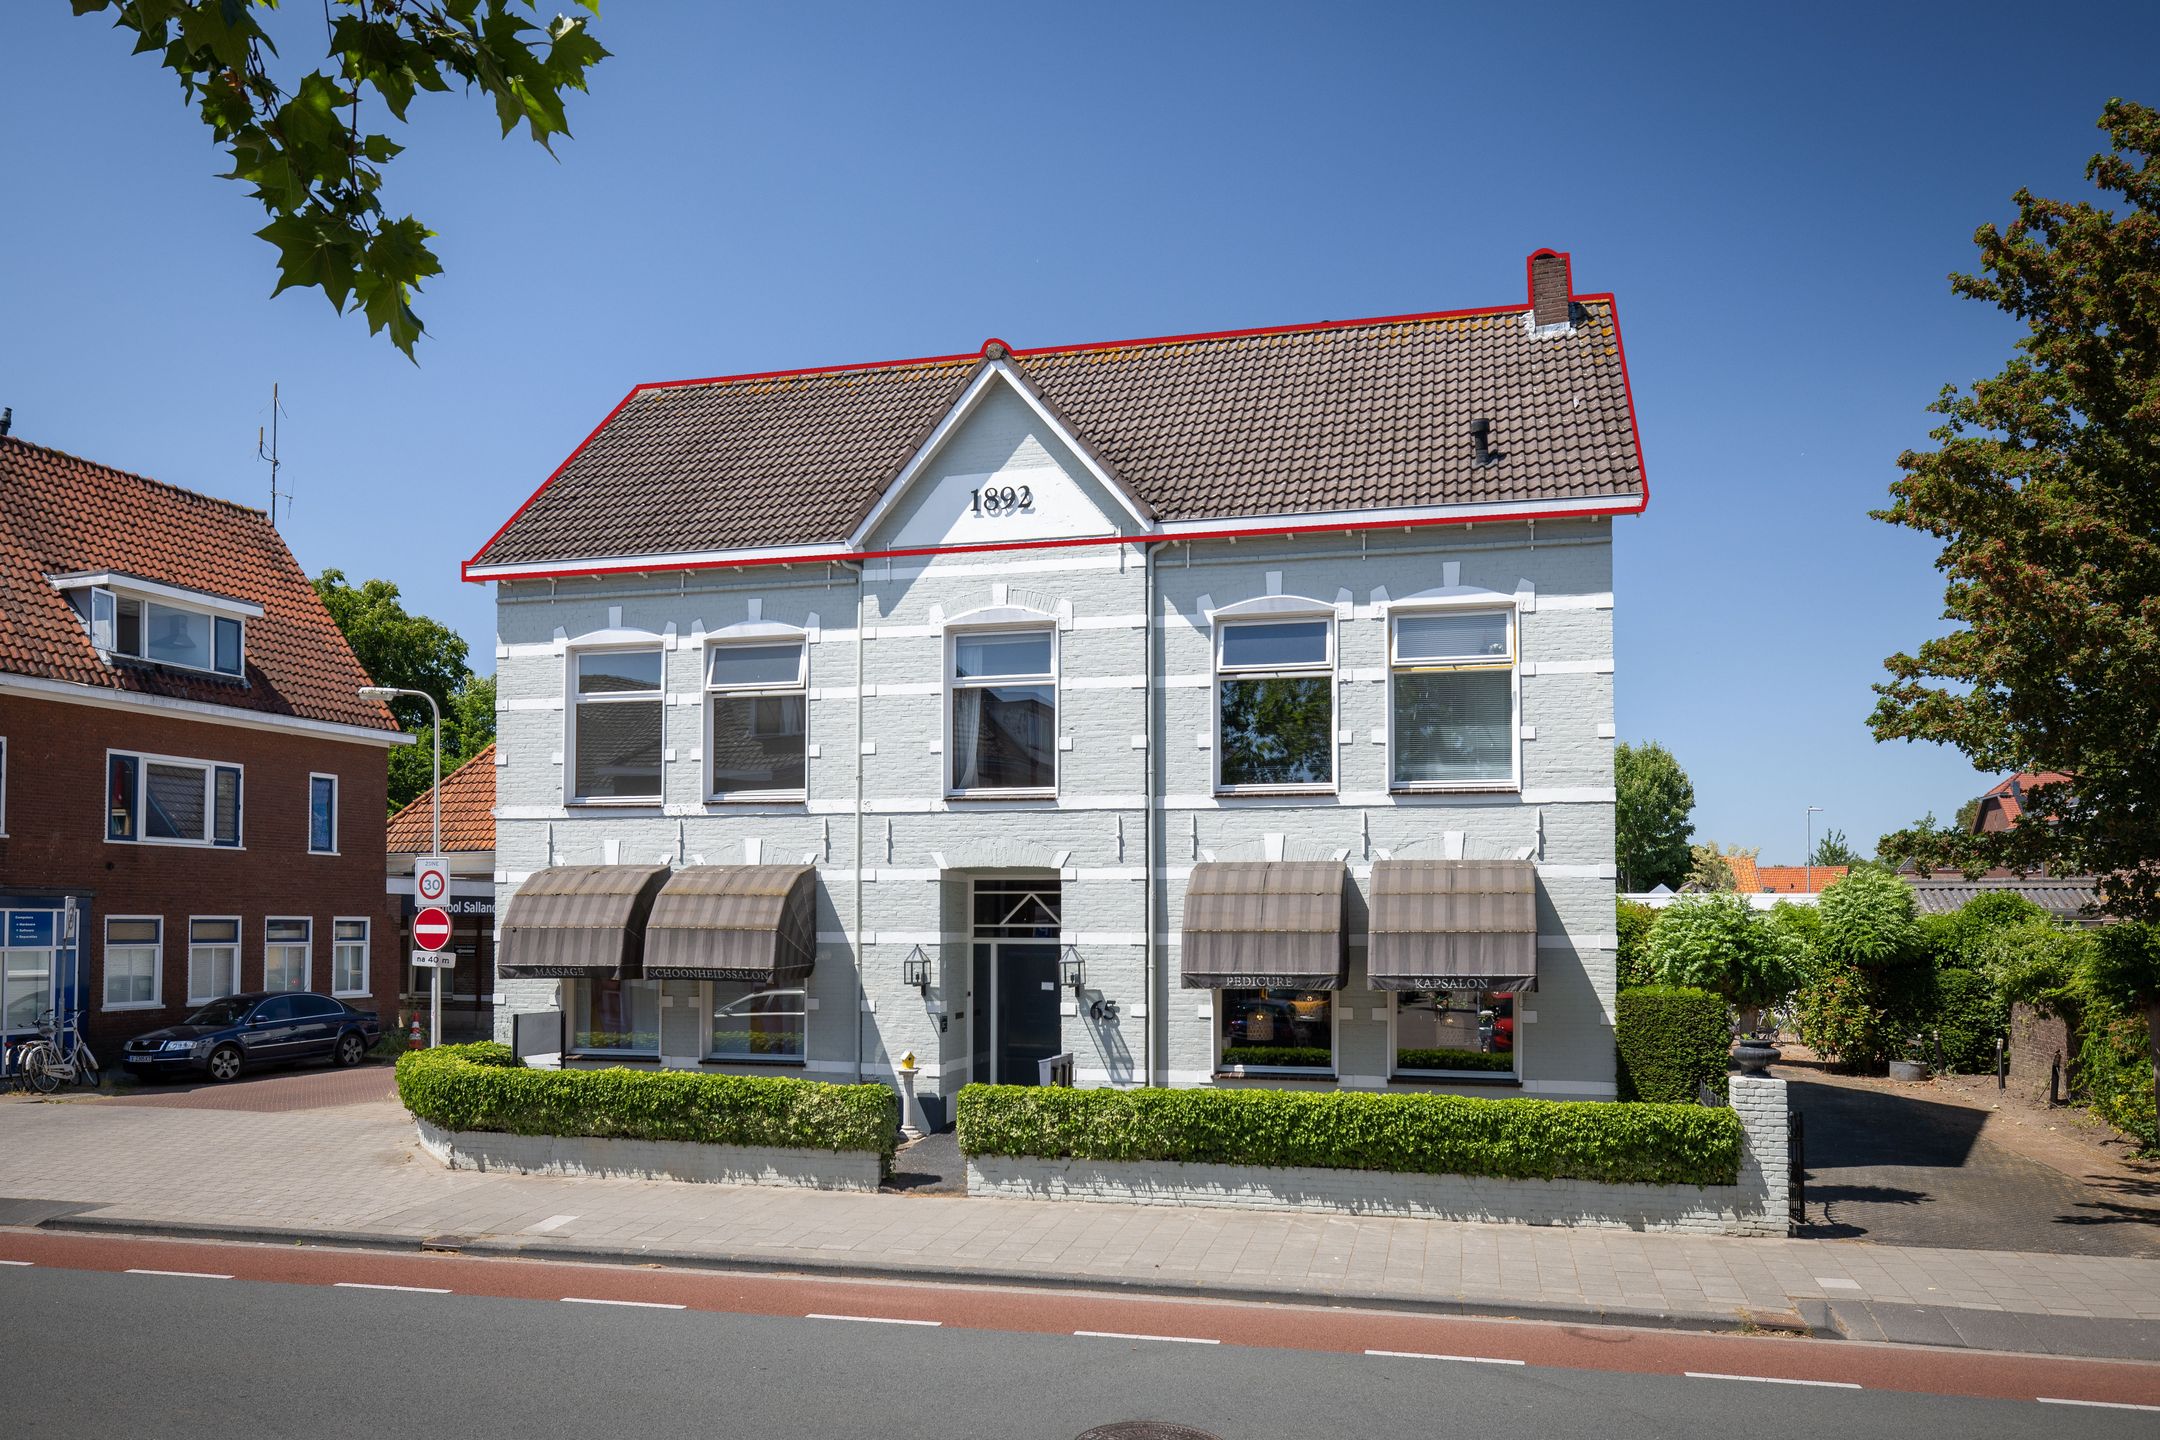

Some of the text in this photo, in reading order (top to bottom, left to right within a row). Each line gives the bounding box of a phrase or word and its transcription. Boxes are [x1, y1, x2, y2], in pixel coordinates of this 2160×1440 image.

[970, 485, 1033, 512] 1892
[424, 879, 441, 891] 30
[427, 956, 440, 964] 40
[534, 967, 585, 977] MASSAGE
[649, 968, 769, 980] SCHOONHEIDSSALON
[1225, 976, 1294, 987] PEDICURE
[1414, 978, 1489, 989] KAPSALON
[1090, 1000, 1117, 1020] 65
